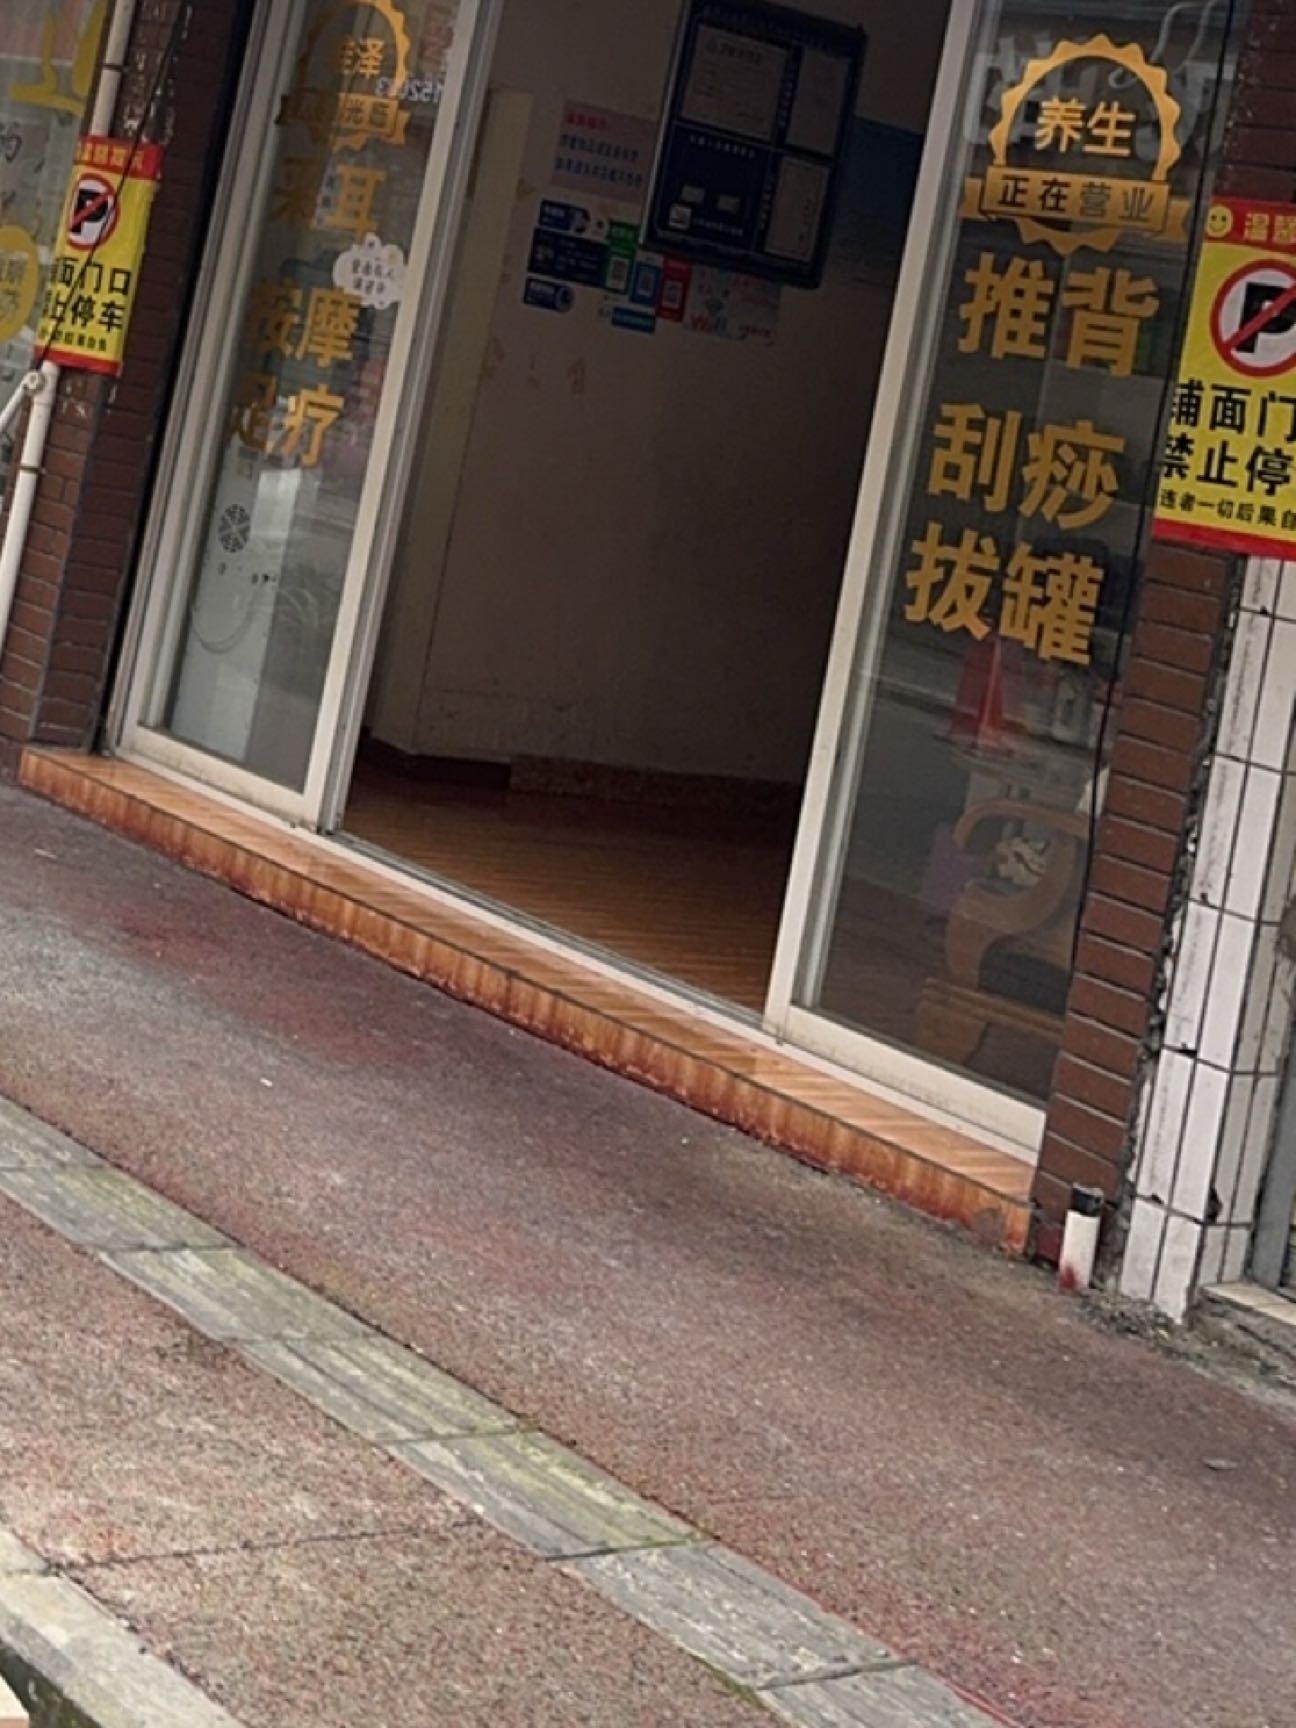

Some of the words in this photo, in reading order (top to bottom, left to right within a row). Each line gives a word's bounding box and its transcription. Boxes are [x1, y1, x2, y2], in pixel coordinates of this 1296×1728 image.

[1033, 96, 1137, 159] 养生
[996, 173, 1156, 224] 正在营业
[244, 282, 363, 369] 按摩
[957, 251, 1160, 378] 推背
[228, 369, 345, 468] 足疗
[927, 401, 1127, 531] 刮痧
[906, 522, 1105, 667] 拔罐
